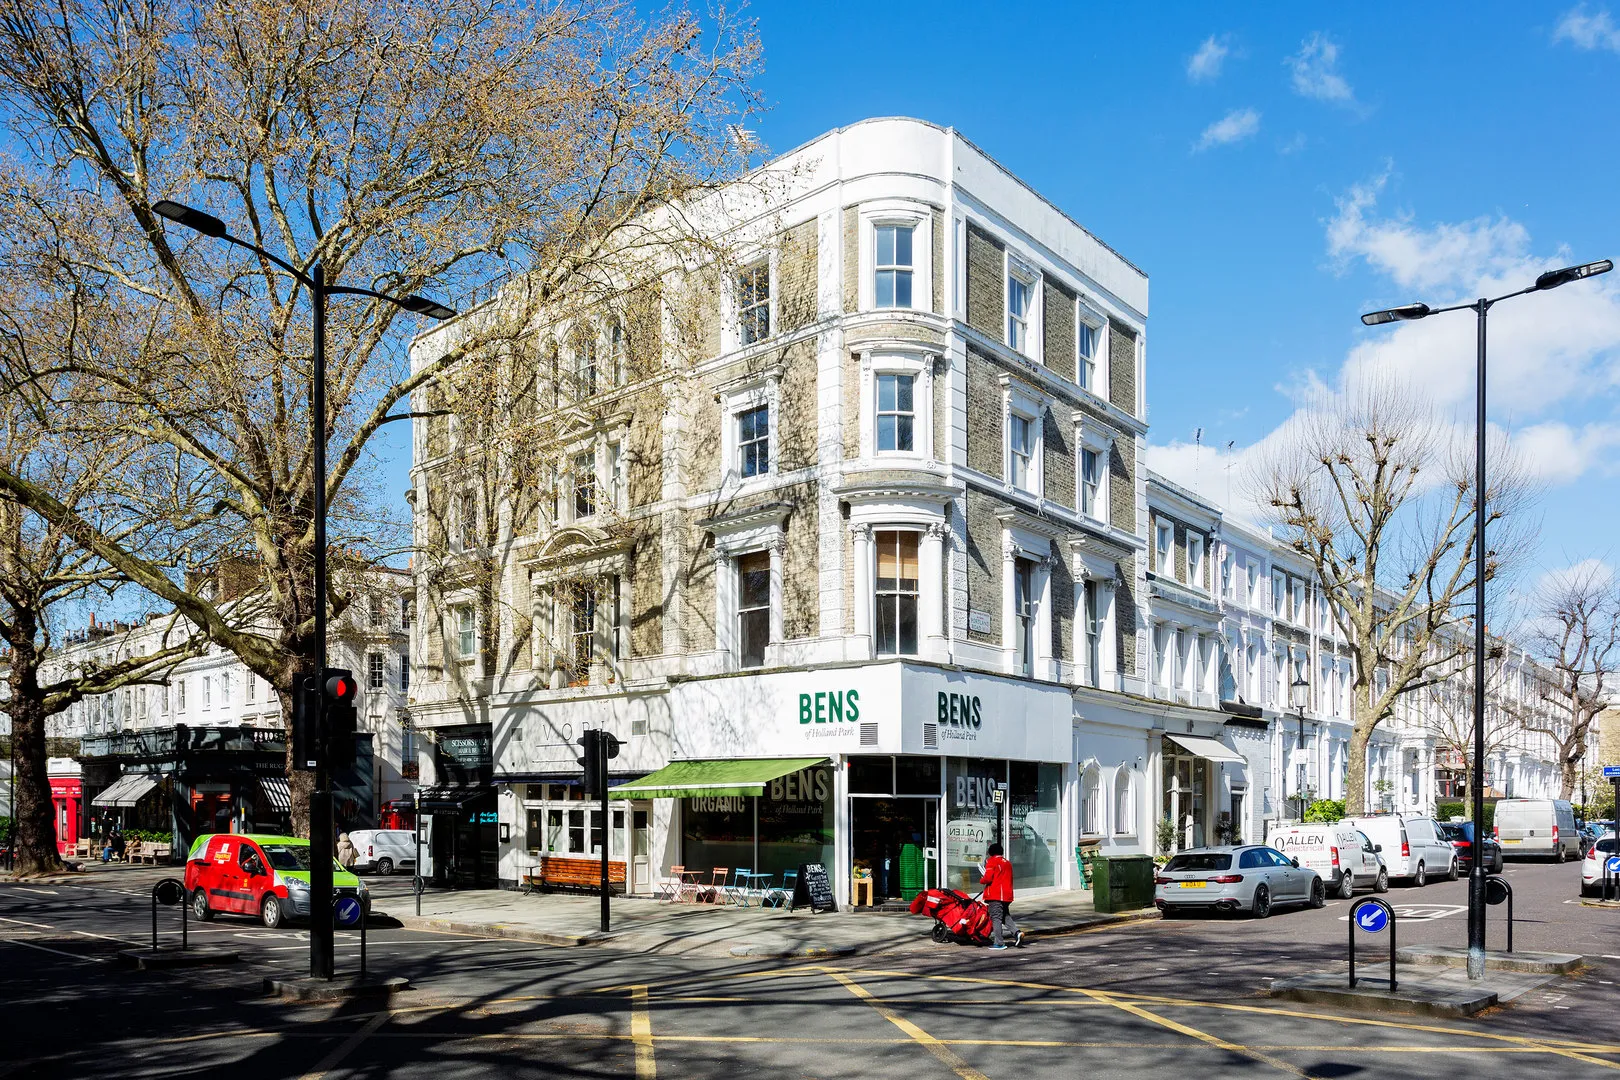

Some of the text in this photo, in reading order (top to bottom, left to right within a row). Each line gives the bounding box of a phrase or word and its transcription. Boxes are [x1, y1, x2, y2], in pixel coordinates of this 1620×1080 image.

[799, 689, 859, 725] BENS
[938, 691, 982, 729] BENS
[812, 727, 837, 738] Holland
[838, 727, 854, 737] Park
[947, 729, 965, 740] Holland
[966, 731, 977, 740] Park
[771, 770, 829, 801] BENS
[956, 776, 996, 810] BENS
[691, 796, 746, 812] ORGANIC
[782, 805, 806, 814] Holland
[807, 805, 823, 814] Park
[1012, 804, 1028, 815] FRESH
[1286, 835, 1324, 846] ALLEN
[1286, 844, 1325, 853] electrical
[806, 864, 822, 873] BENS
